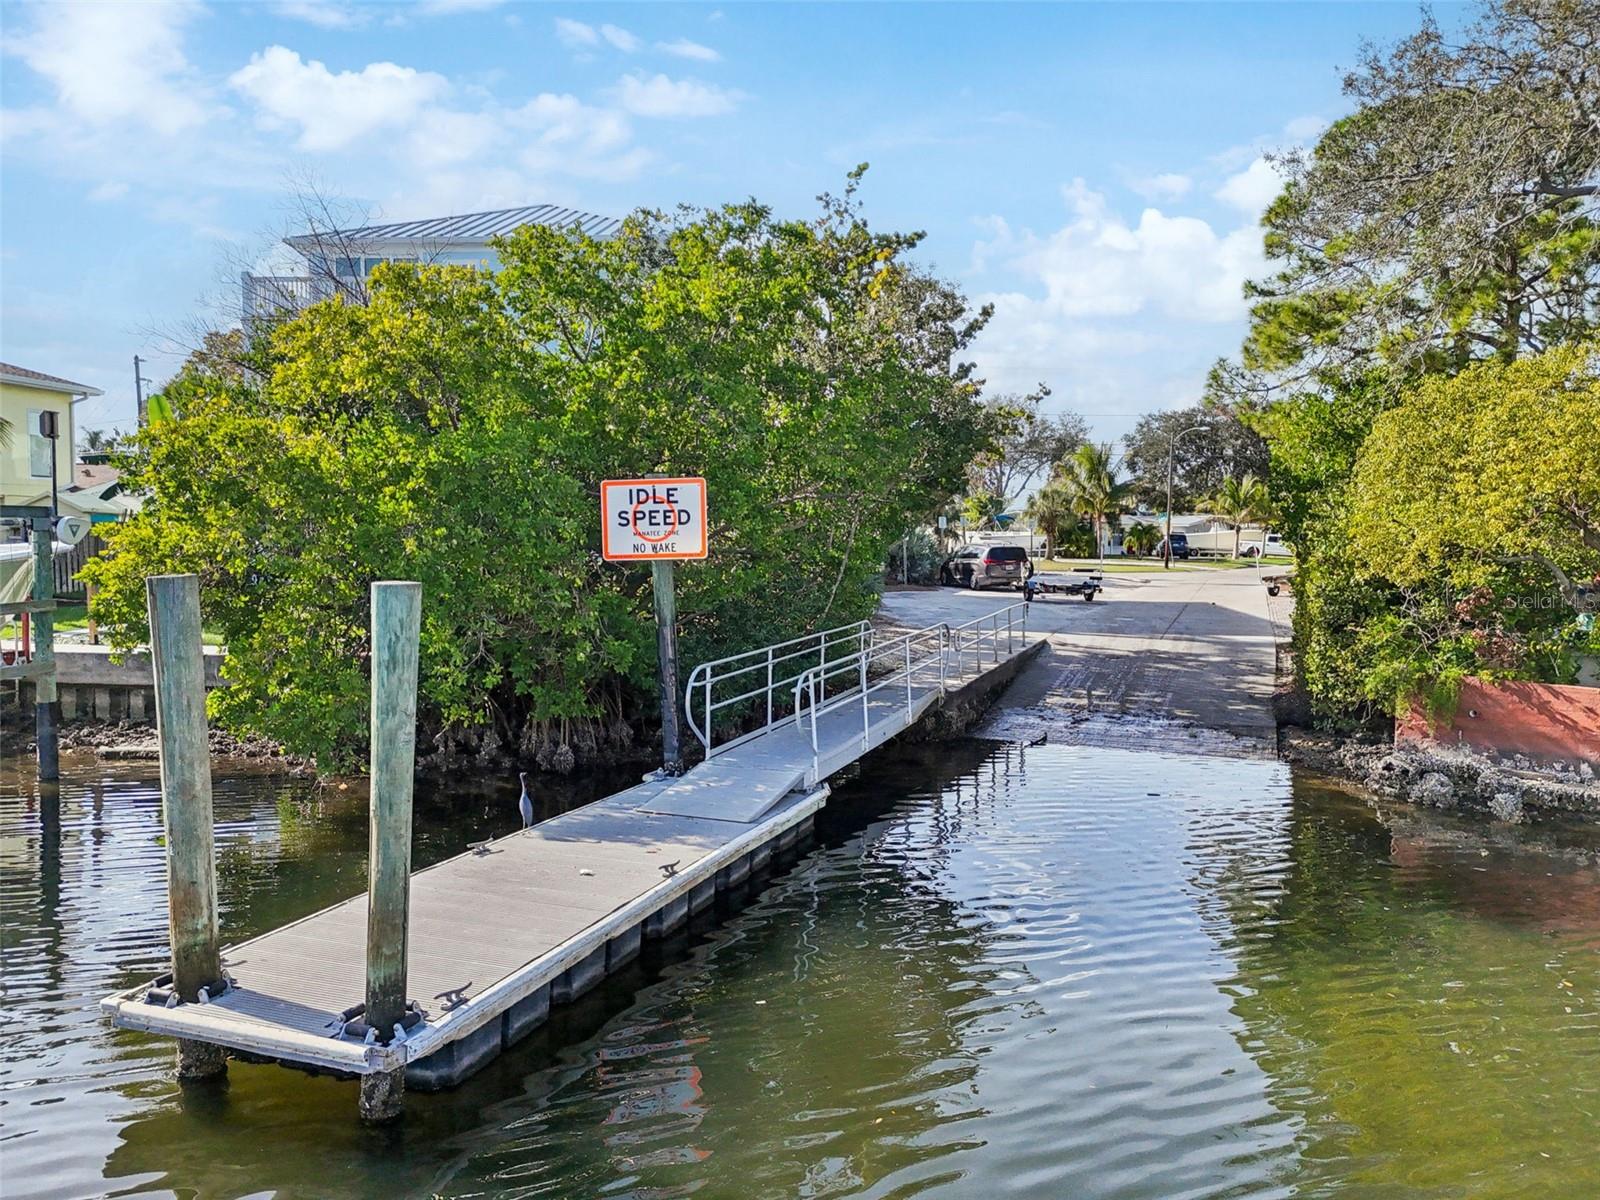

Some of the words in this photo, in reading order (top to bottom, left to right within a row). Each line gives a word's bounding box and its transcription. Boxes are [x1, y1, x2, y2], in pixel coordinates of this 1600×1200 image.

[629, 488, 678, 505] IDLE
[618, 509, 691, 527] SPEED
[633, 543, 646, 553] NO
[651, 542, 677, 553] WAKE
